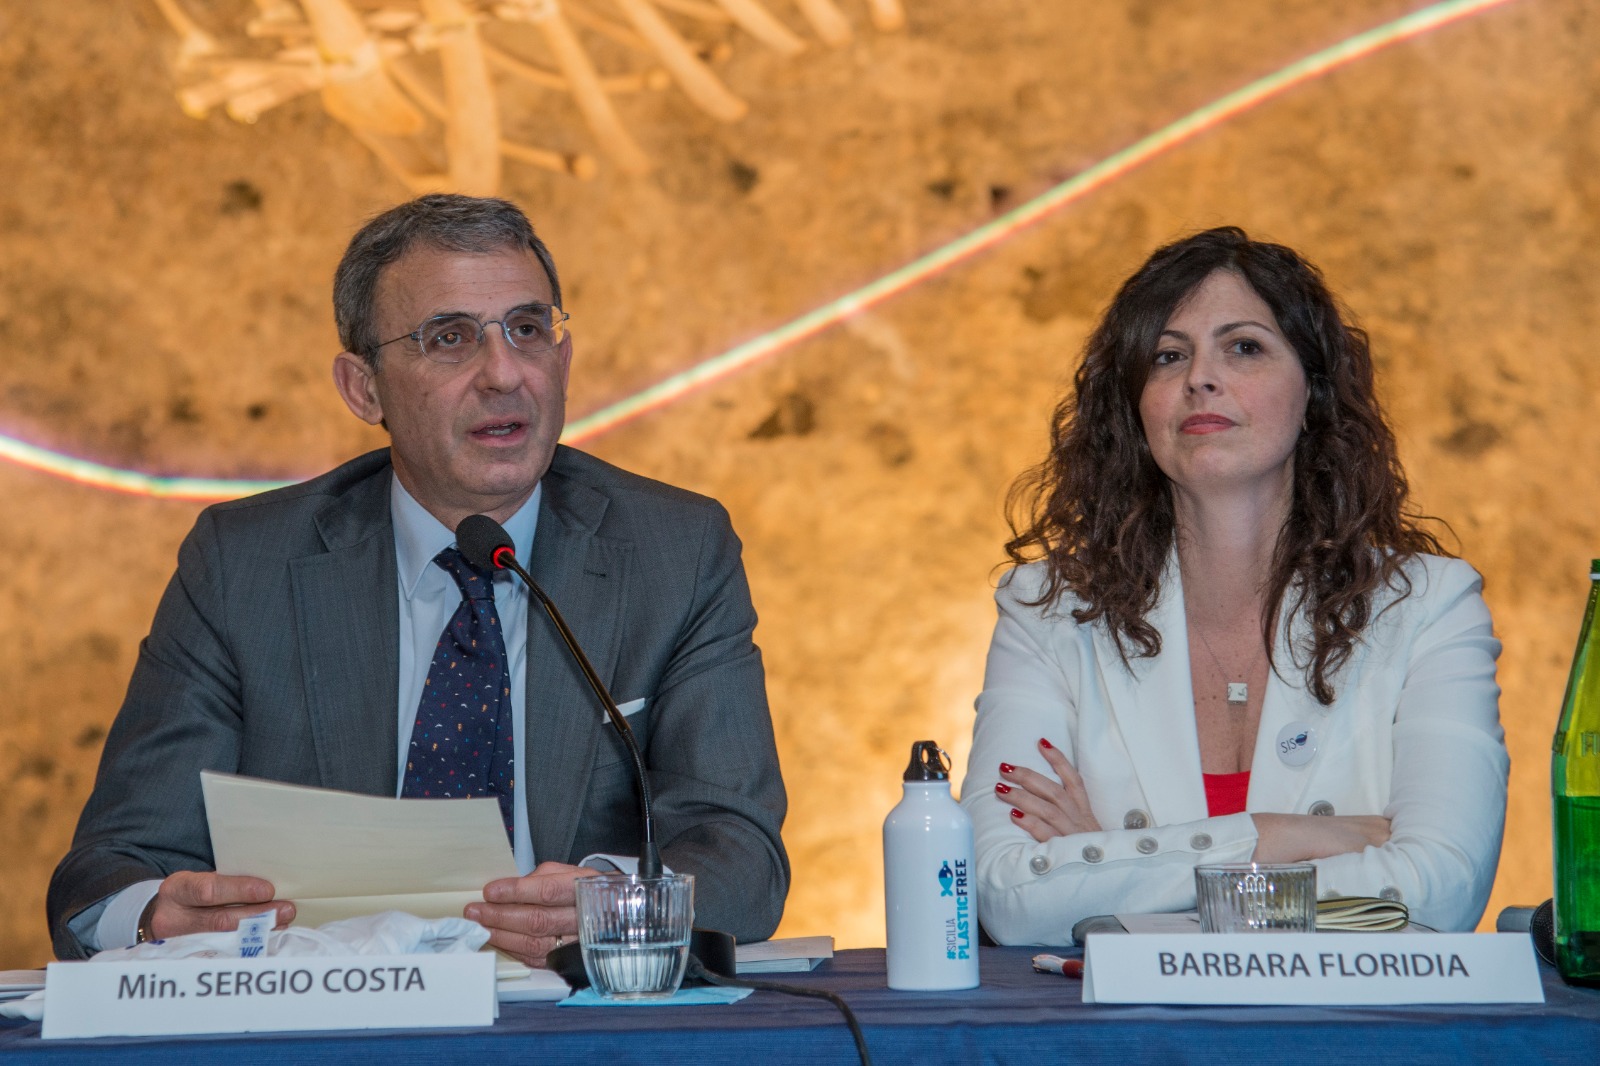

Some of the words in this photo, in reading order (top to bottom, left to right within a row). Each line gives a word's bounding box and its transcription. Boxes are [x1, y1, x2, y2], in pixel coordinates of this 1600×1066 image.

[955, 858, 970, 960] PLASTICFREE
[946, 918, 957, 960] #SICILIA
[117, 973, 186, 1000] Min.
[195, 969, 314, 998] SERGIO
[322, 966, 426, 994] COSTA
[1158, 951, 1311, 978] BARBARA
[1320, 952, 1470, 978] FLORIDIA
